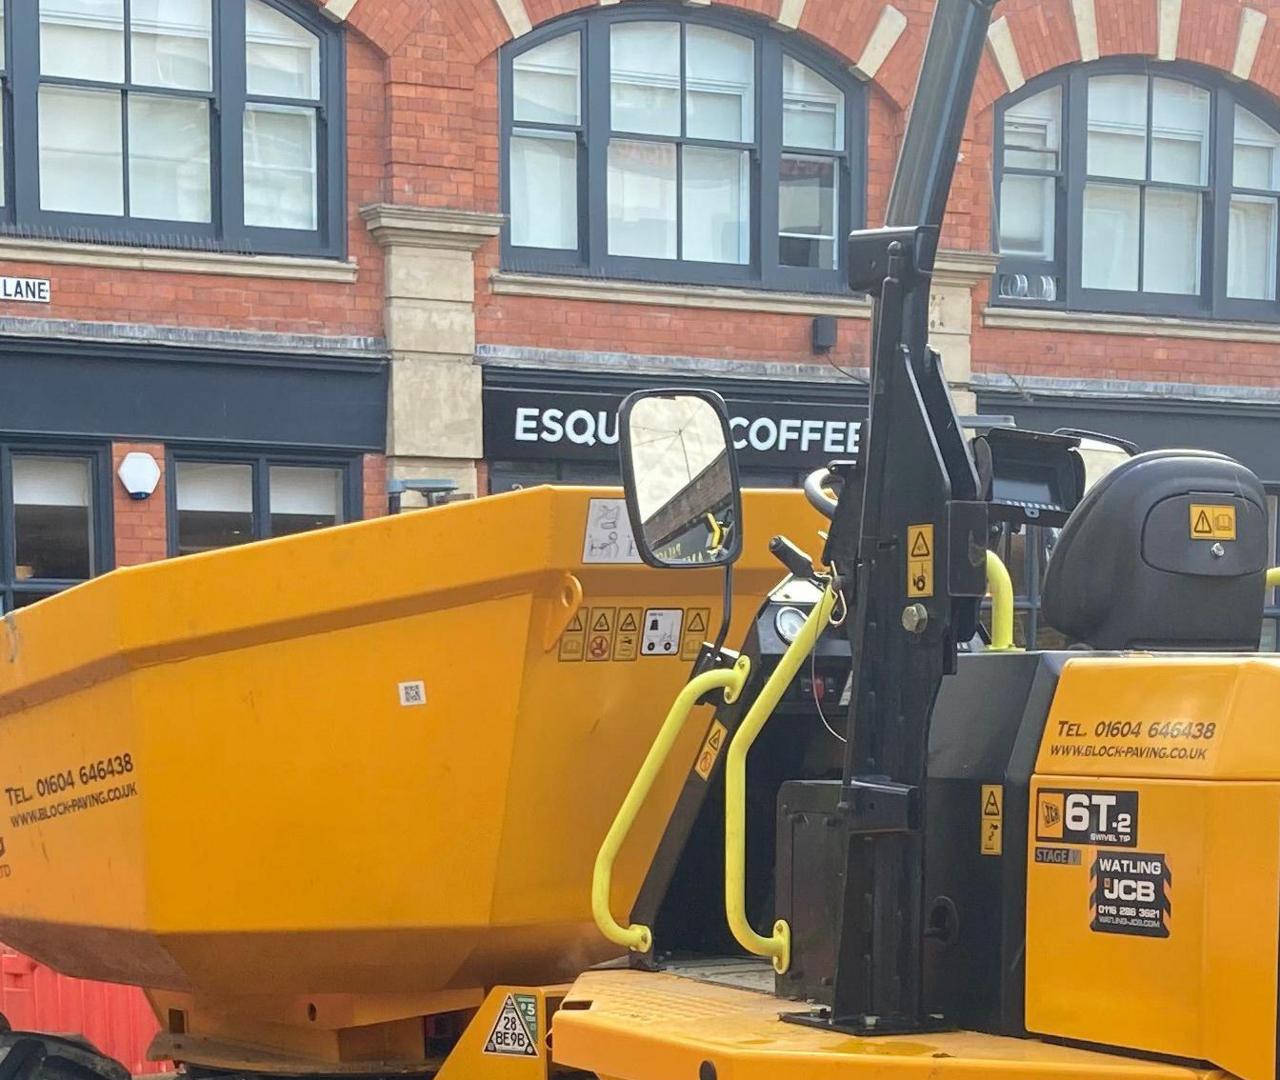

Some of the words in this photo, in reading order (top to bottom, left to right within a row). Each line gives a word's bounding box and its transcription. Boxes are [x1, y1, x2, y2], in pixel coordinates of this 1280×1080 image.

[3, 279, 47, 300] LANE
[514, 406, 622, 447] ESQU
[729, 416, 862, 454] COFFEE
[1057, 720, 1087, 738] TEL.
[1094, 720, 1143, 738] 01604
[1147, 721, 1217, 740] 646438
[1050, 744, 1209, 760] WWW.BLOCK-PAVING.CO.UK
[5, 786, 32, 807] TEL.
[36, 770, 75, 798] 01604
[78, 752, 134, 786] 646438
[10, 781, 138, 829] WWW.BLOCK-PAVING.CO.UK
[1090, 833, 1118, 843] SWIVEL
[1119, 834, 1131, 843] TIP
[1036, 848, 1068, 864] STAGE
[1099, 858, 1162, 875] WATLING
[1104, 878, 1156, 903] JCB
[503, 1016, 518, 1031] 28
[495, 1031, 526, 1048] BE9B
